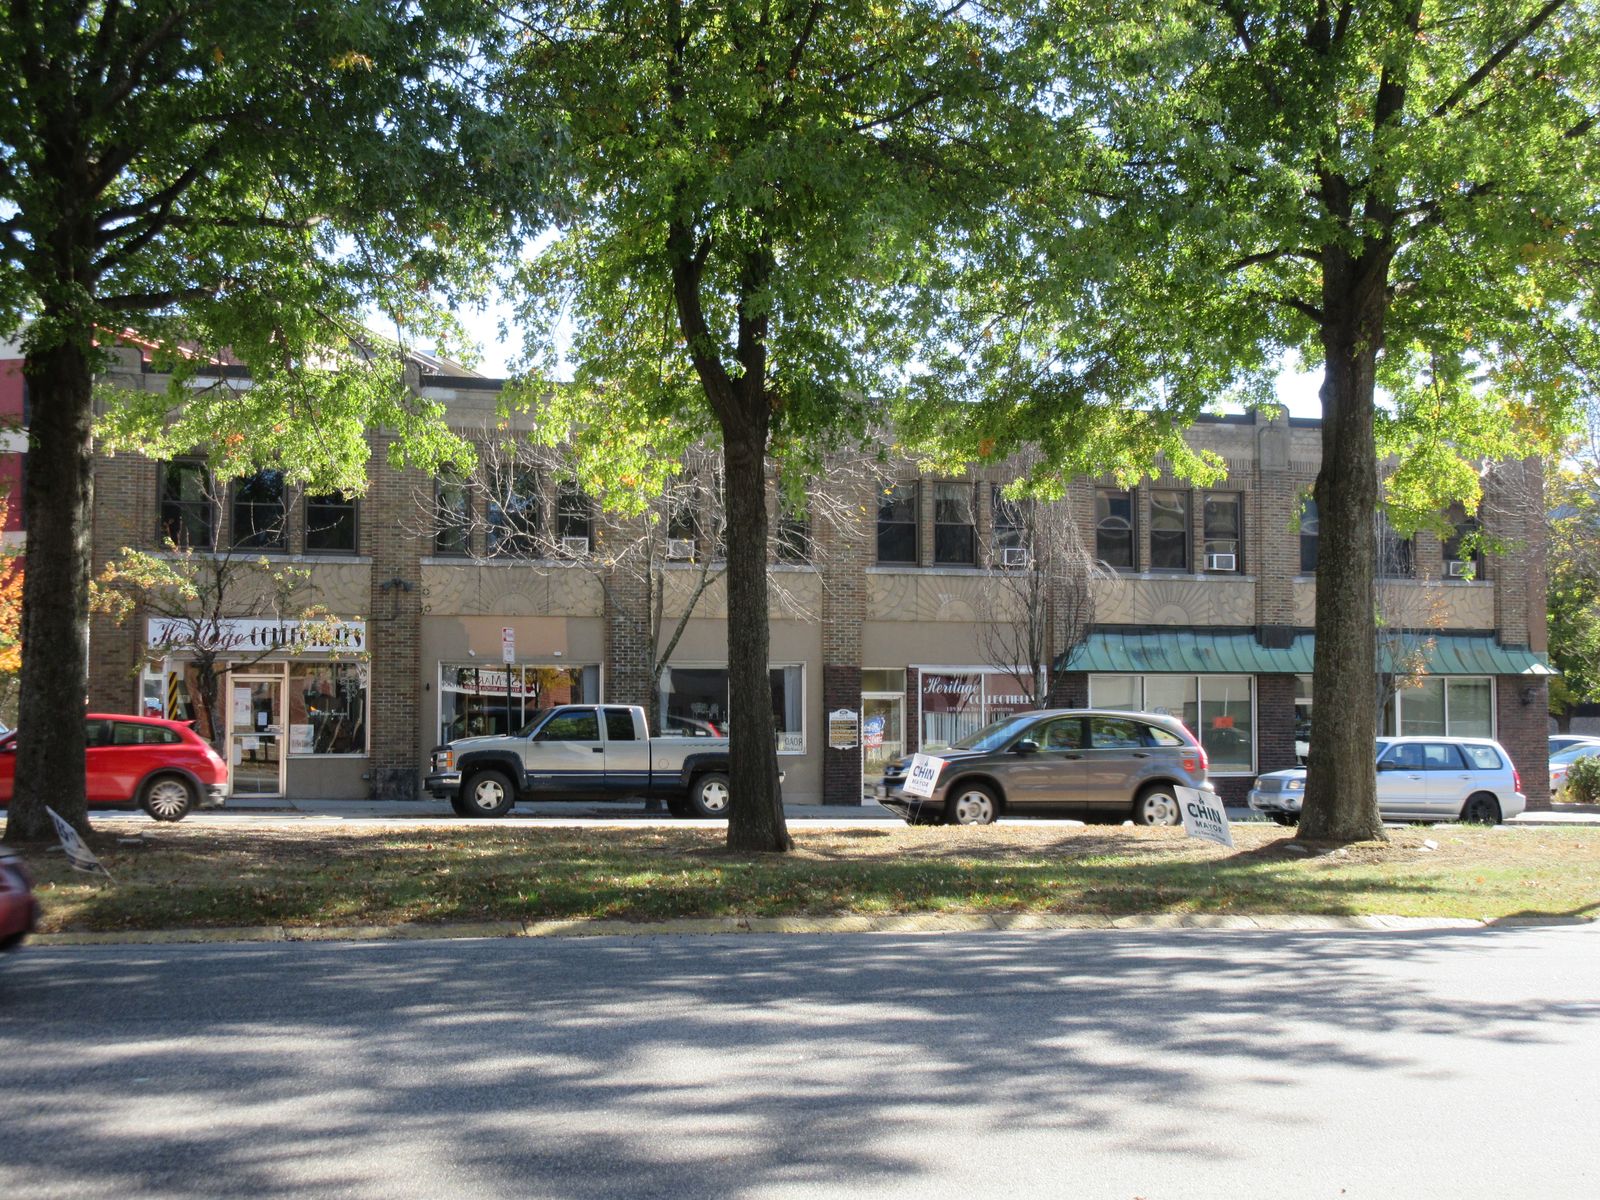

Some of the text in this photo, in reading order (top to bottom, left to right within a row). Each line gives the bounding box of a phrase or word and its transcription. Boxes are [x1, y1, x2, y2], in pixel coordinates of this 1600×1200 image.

[152, 622, 244, 651] Hertge
[923, 677, 979, 700] Heritage
[911, 778, 929, 787] MAYOR
[912, 765, 935, 781] CHIN
[1187, 802, 1222, 825] CHIN
[1194, 820, 1222, 834] MAYOR
